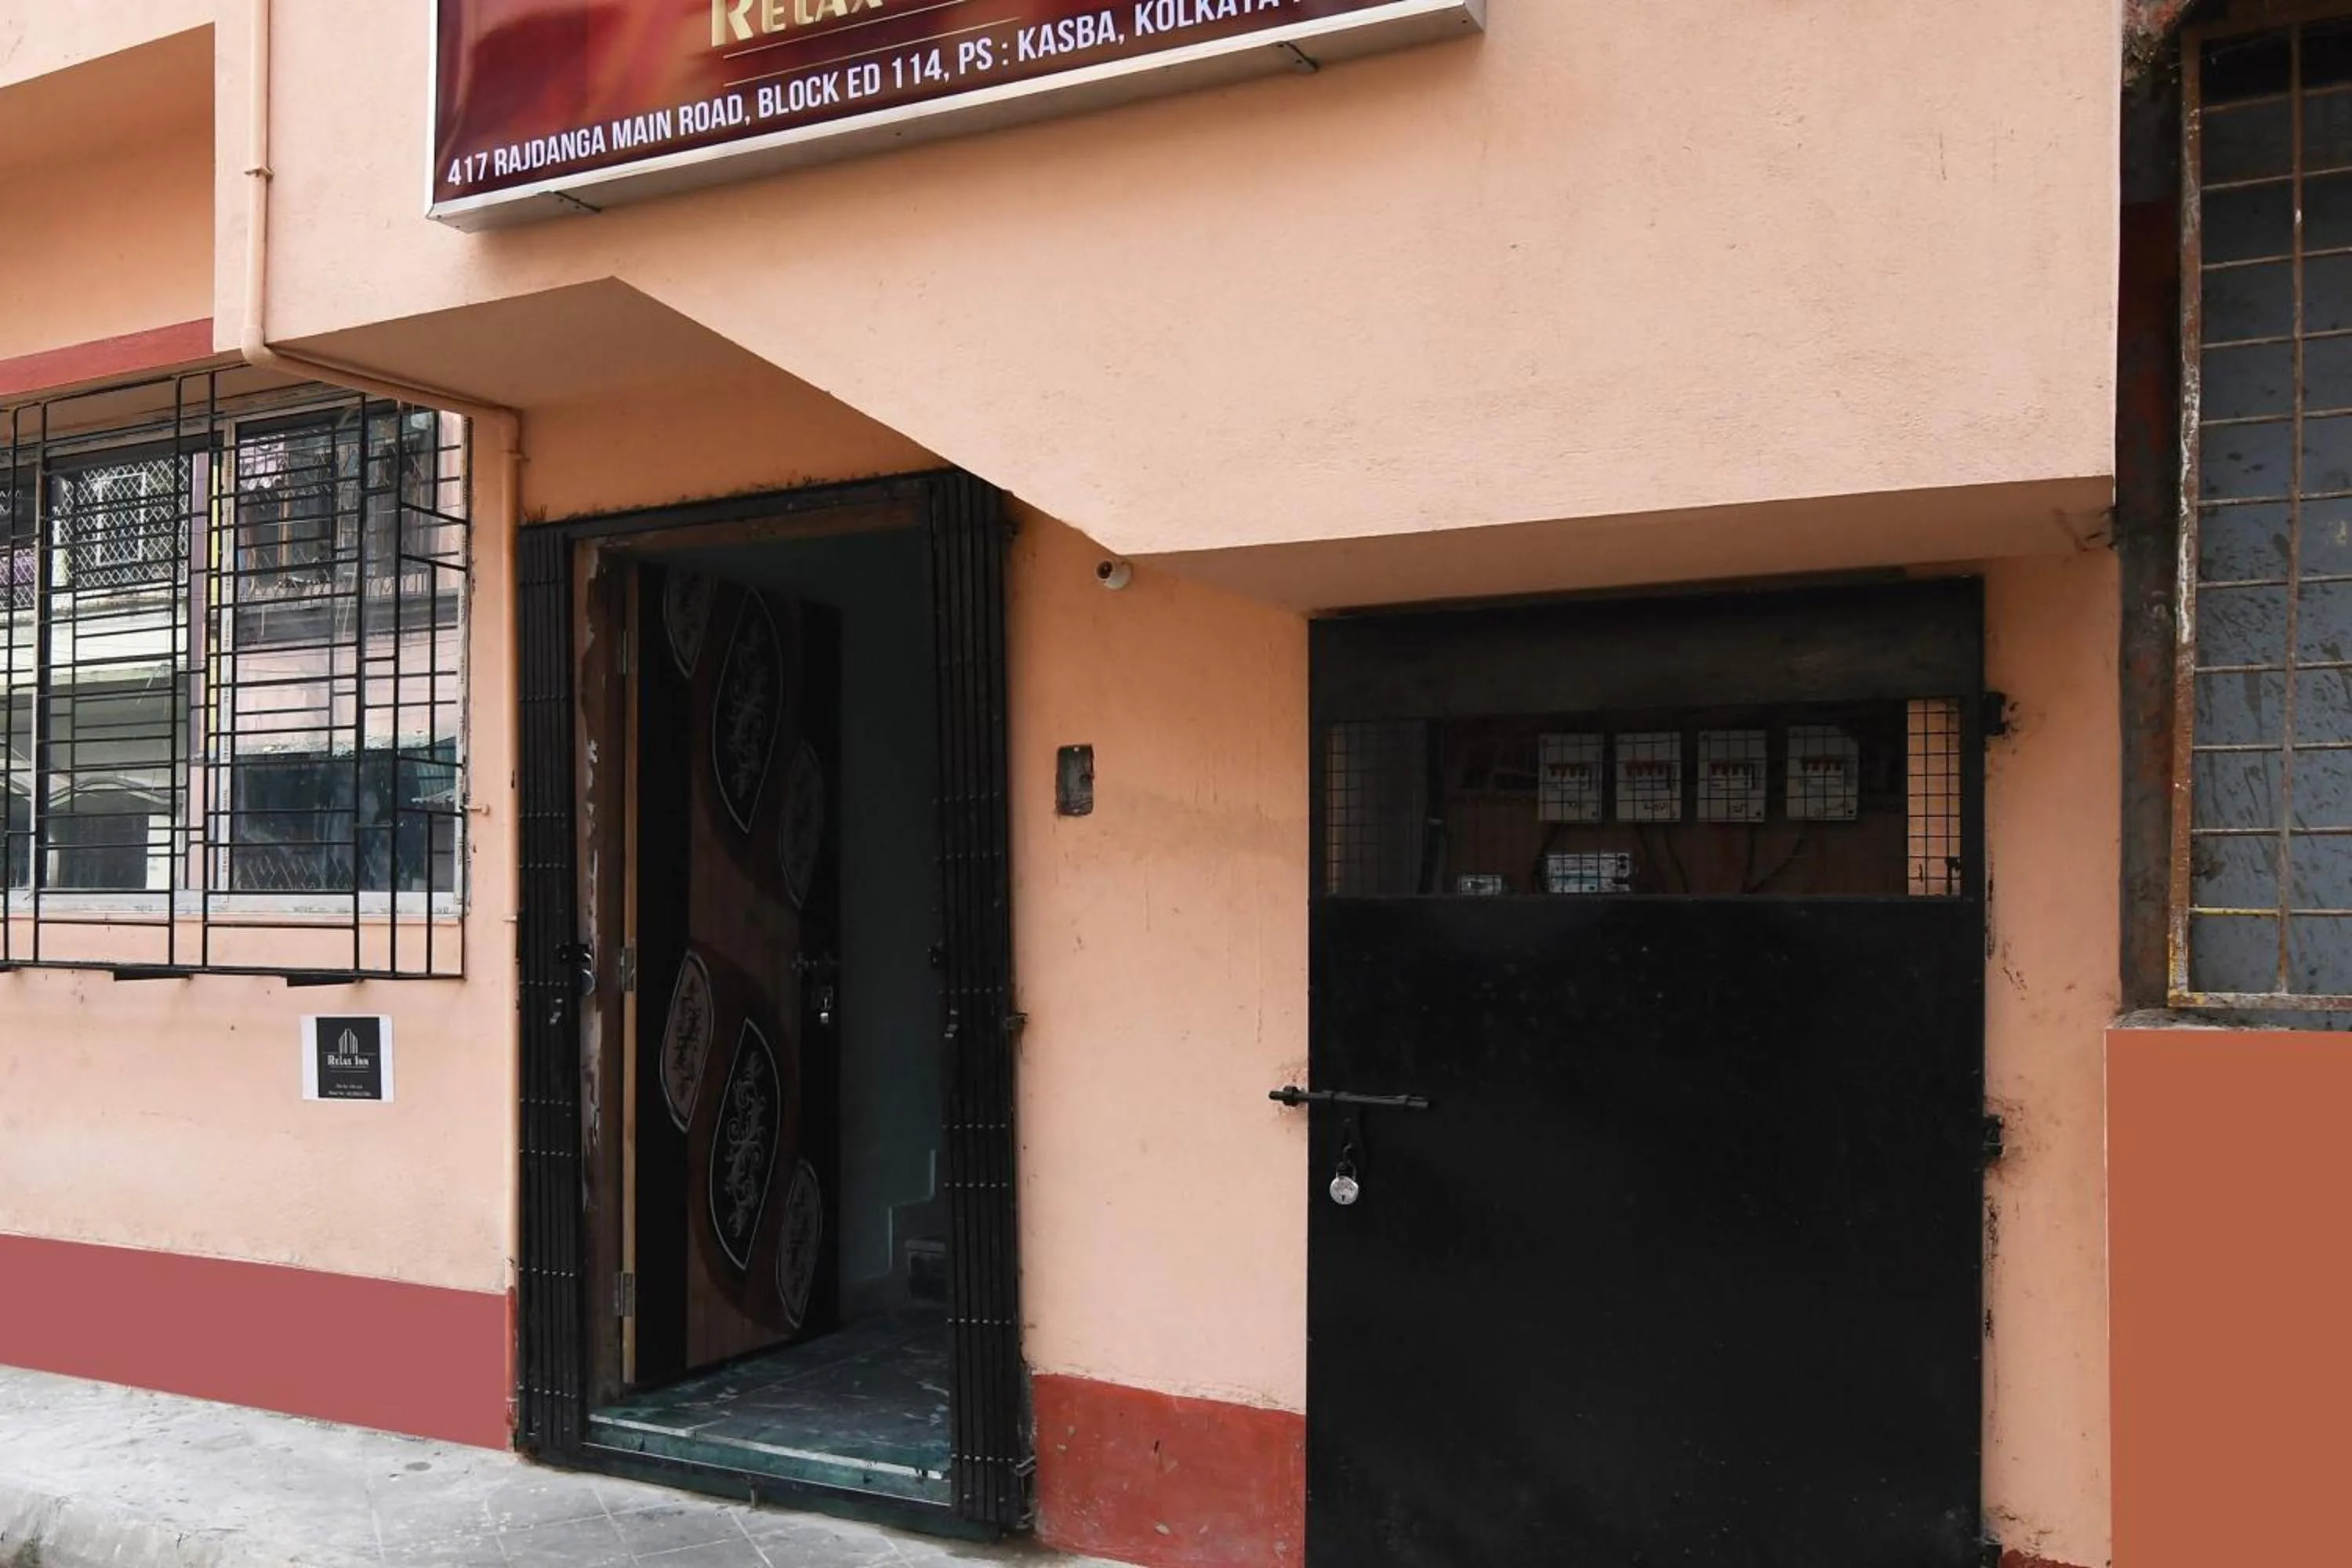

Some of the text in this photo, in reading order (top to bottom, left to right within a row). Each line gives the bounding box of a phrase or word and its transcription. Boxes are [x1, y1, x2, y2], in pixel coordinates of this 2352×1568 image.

[711, 0, 884, 47] REL
[447, 151, 488, 186] 417
[494, 125, 606, 176] RAJDANGA
[612, 109, 672, 151] MAIN
[678, 94, 750, 136] ROAD,
[758, 71, 840, 118] BLOCK
[848, 64, 880, 99] ED
[891, 49, 949, 89] 114,
[1018, 10, 1125, 62] KASBA,
[1134, 0, 1279, 37] KOLKA
